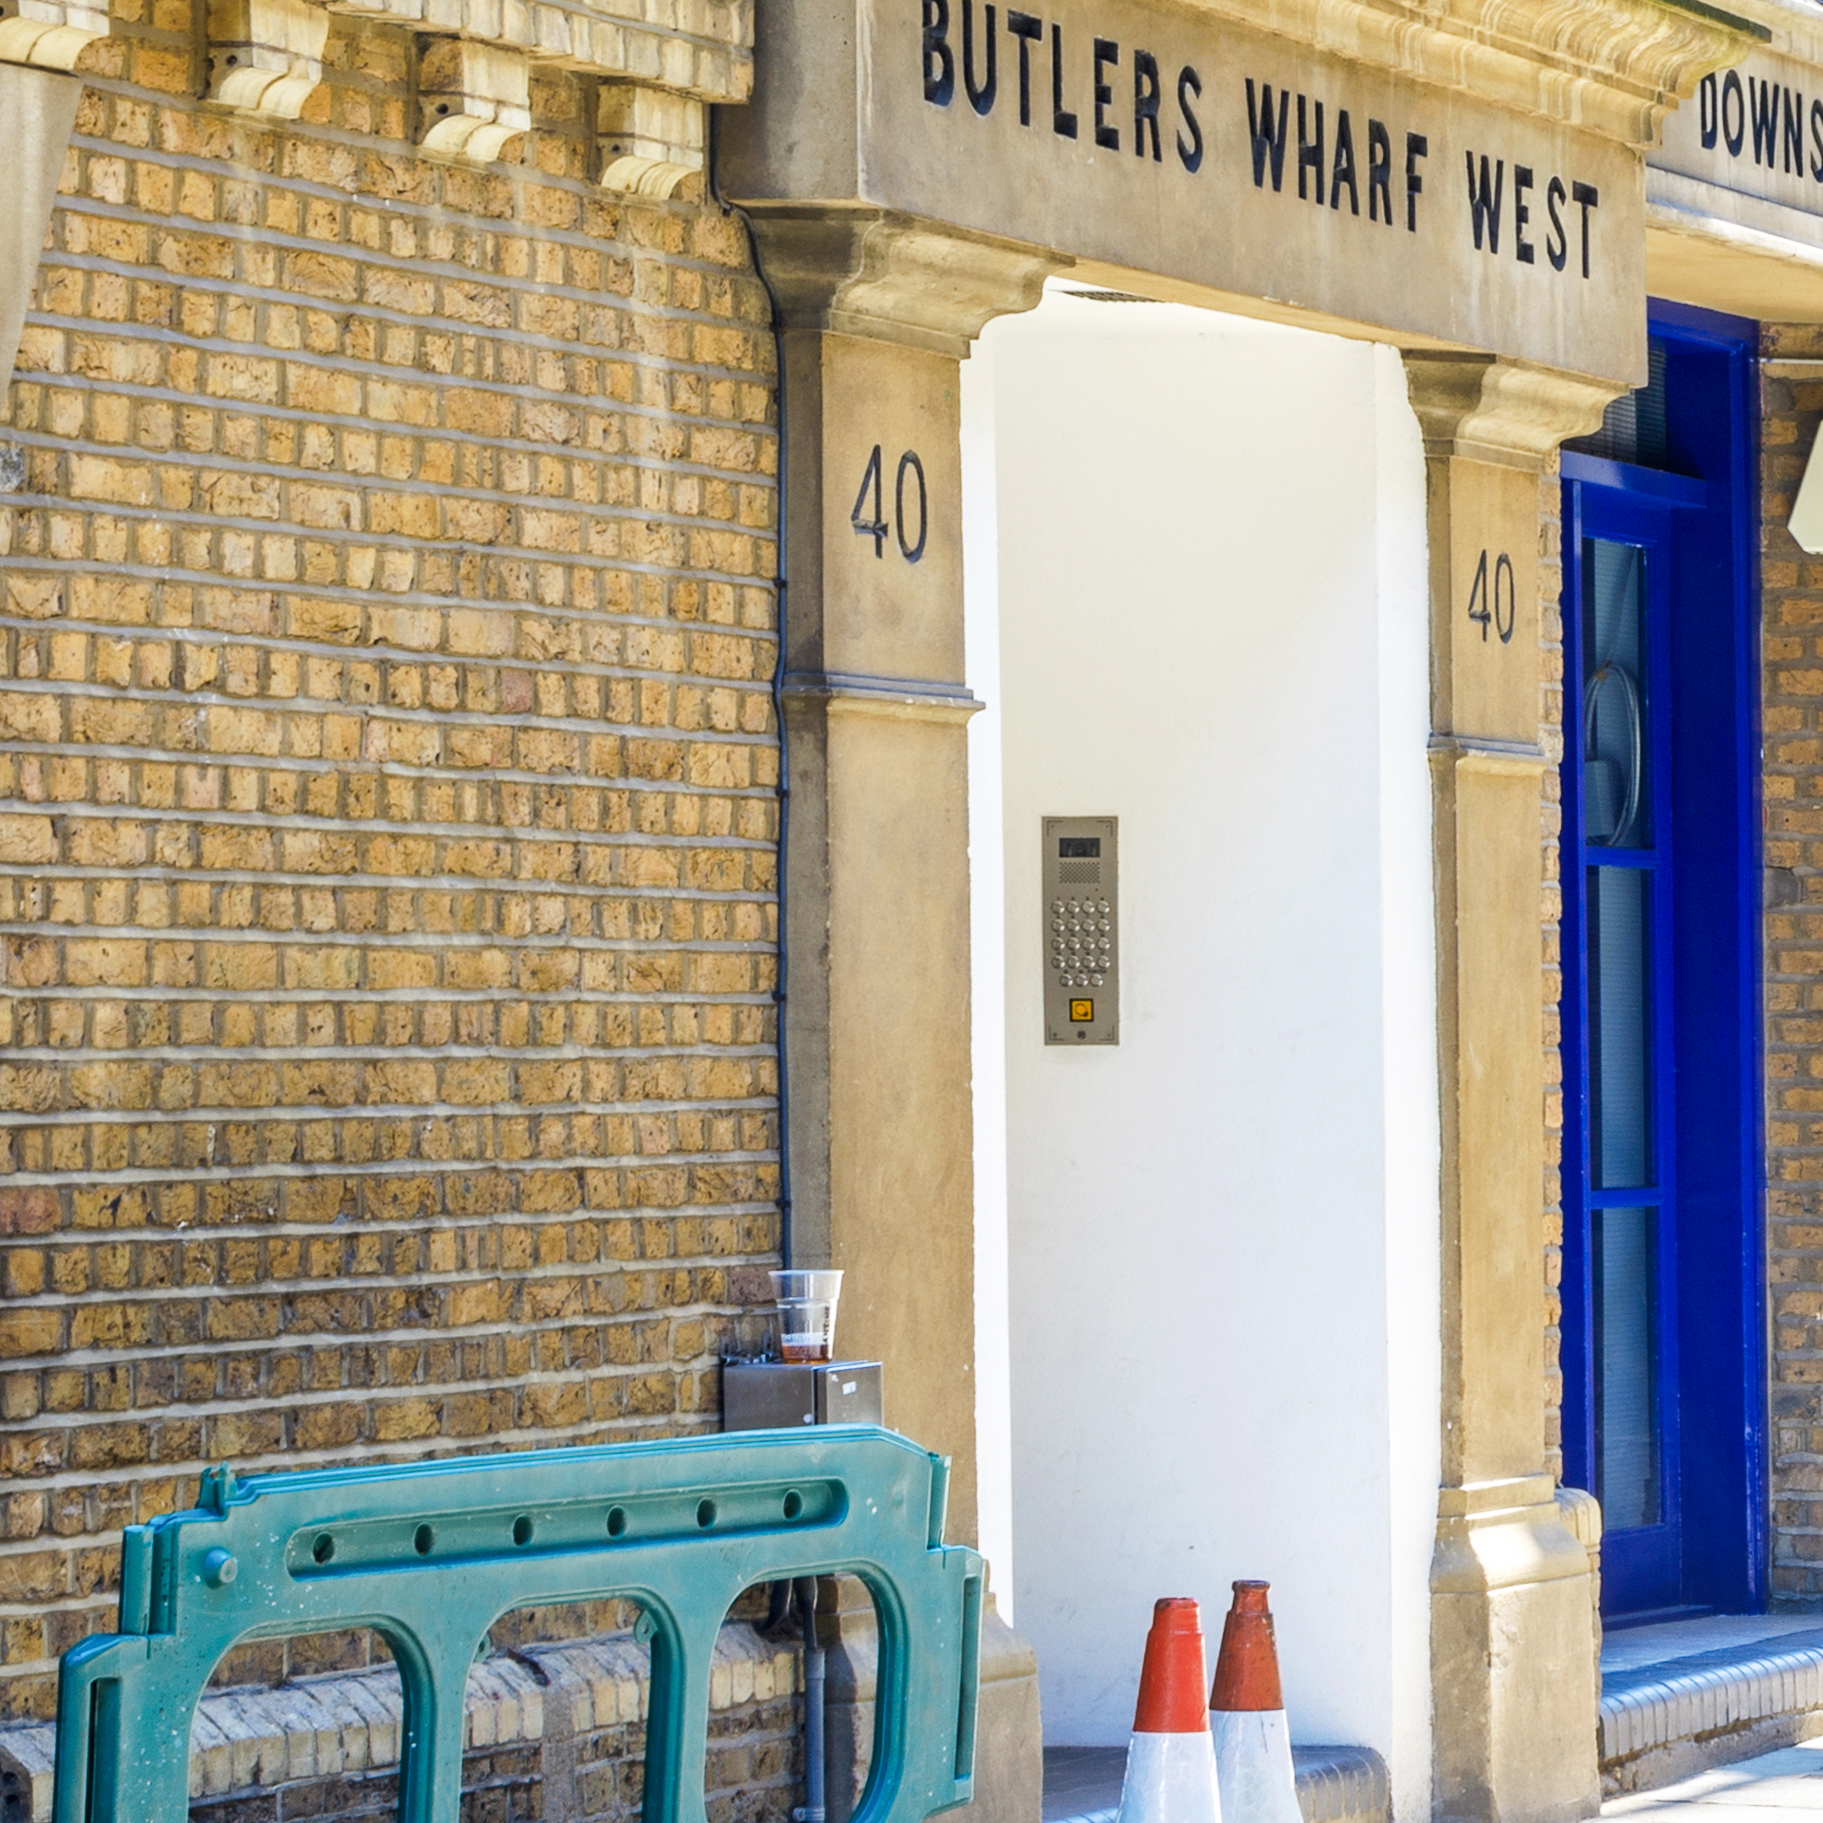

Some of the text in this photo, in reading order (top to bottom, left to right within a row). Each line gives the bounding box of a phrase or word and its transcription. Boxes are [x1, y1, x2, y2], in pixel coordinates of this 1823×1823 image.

[1244, 76, 1429, 234] WHARF
[1465, 149, 1600, 280] WEST
[850, 443, 929, 564] 40
[1467, 548, 1516, 644] 40
